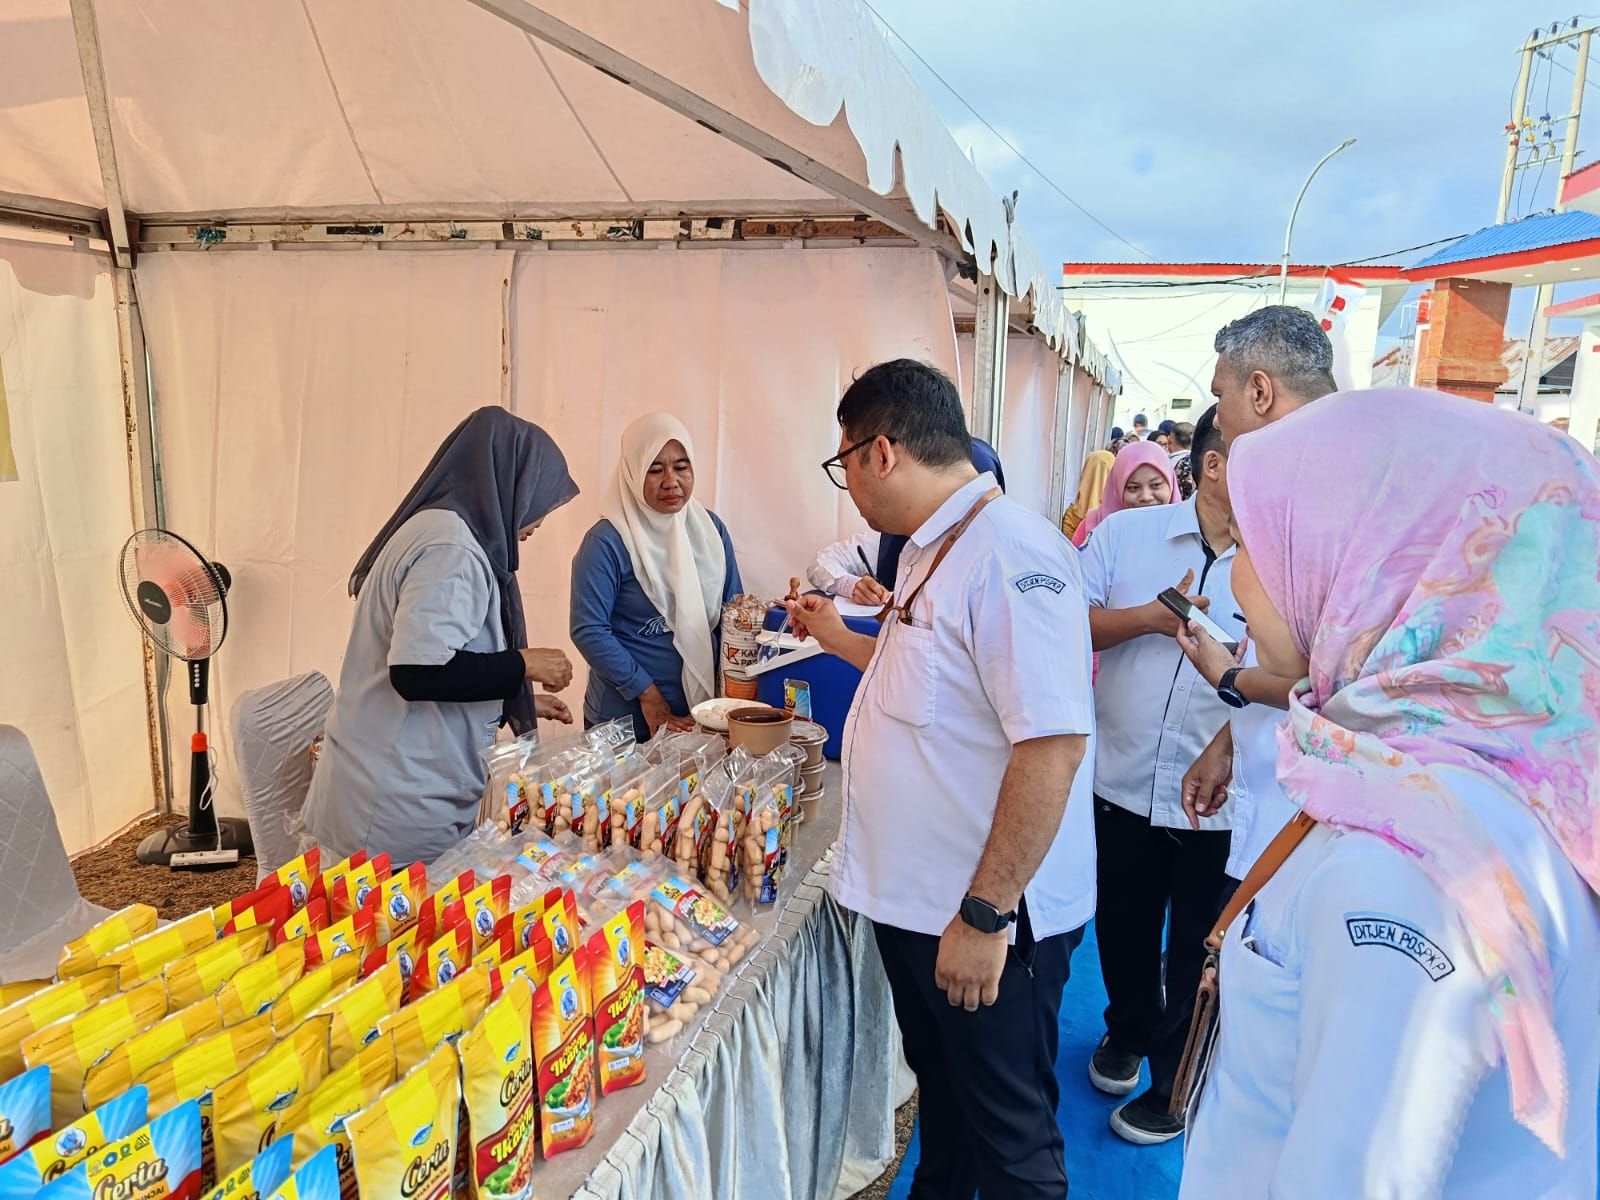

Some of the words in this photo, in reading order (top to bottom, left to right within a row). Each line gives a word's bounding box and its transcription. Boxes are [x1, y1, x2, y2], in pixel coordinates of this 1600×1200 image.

[1354, 924, 1396, 942] DITJEN
[93, 1157, 169, 1200] Ceria
[401, 1139, 449, 1198] Ceria
